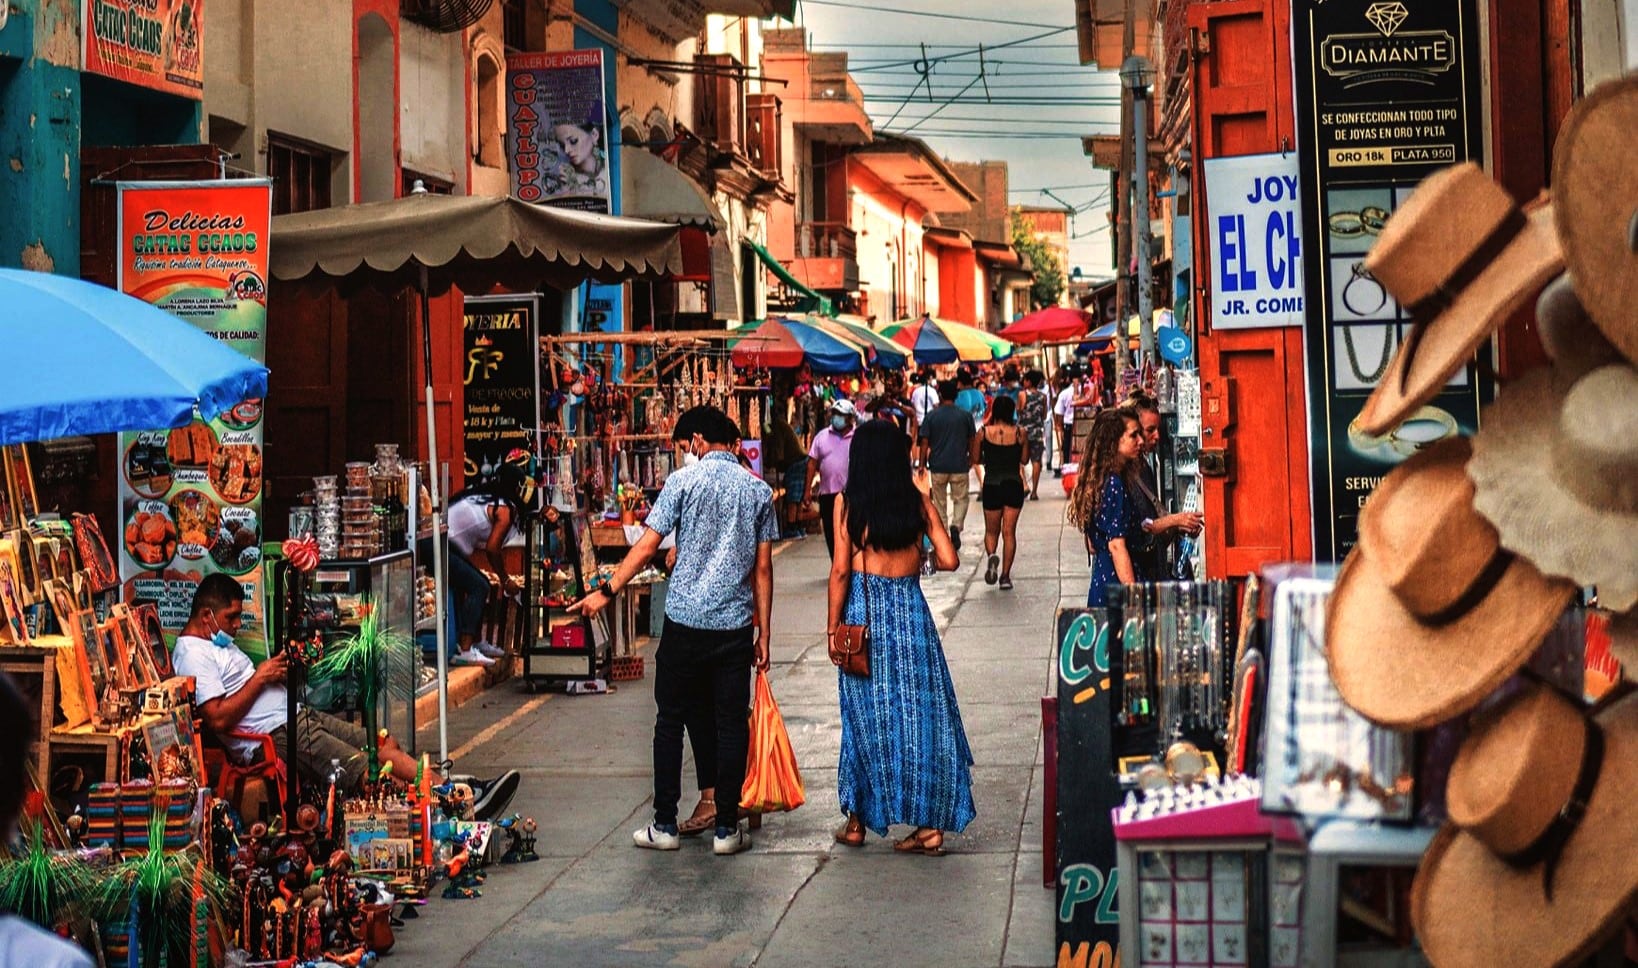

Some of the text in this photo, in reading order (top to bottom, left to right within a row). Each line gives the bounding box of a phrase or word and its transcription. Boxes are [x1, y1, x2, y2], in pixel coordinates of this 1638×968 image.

[1331, 41, 1448, 64] DIAMANTE
[510, 57, 542, 69] TALLER
[545, 56, 558, 68] DE
[1321, 108, 1457, 125] SE CONFECCIONAN TODO TIPO
[512, 73, 542, 201] GUAYLUPO
[1334, 125, 1446, 140] DE JOYAS EN ORO Y PLTA
[1336, 151, 1385, 162] ORO 18k
[1393, 148, 1452, 160] PLATA 950
[1247, 175, 1298, 204] JOY
[144, 210, 245, 231] Delicias
[133, 233, 257, 255] CATAC CCAOS
[1218, 214, 1257, 292] EL
[1222, 300, 1250, 315] JR.
[219, 331, 229, 339] DE
[468, 402, 501, 414] Venta de
[471, 416, 480, 427] 18
[495, 415, 516, 427] Plata
[466, 430, 494, 442] mayor
[494, 430, 500, 441] y
